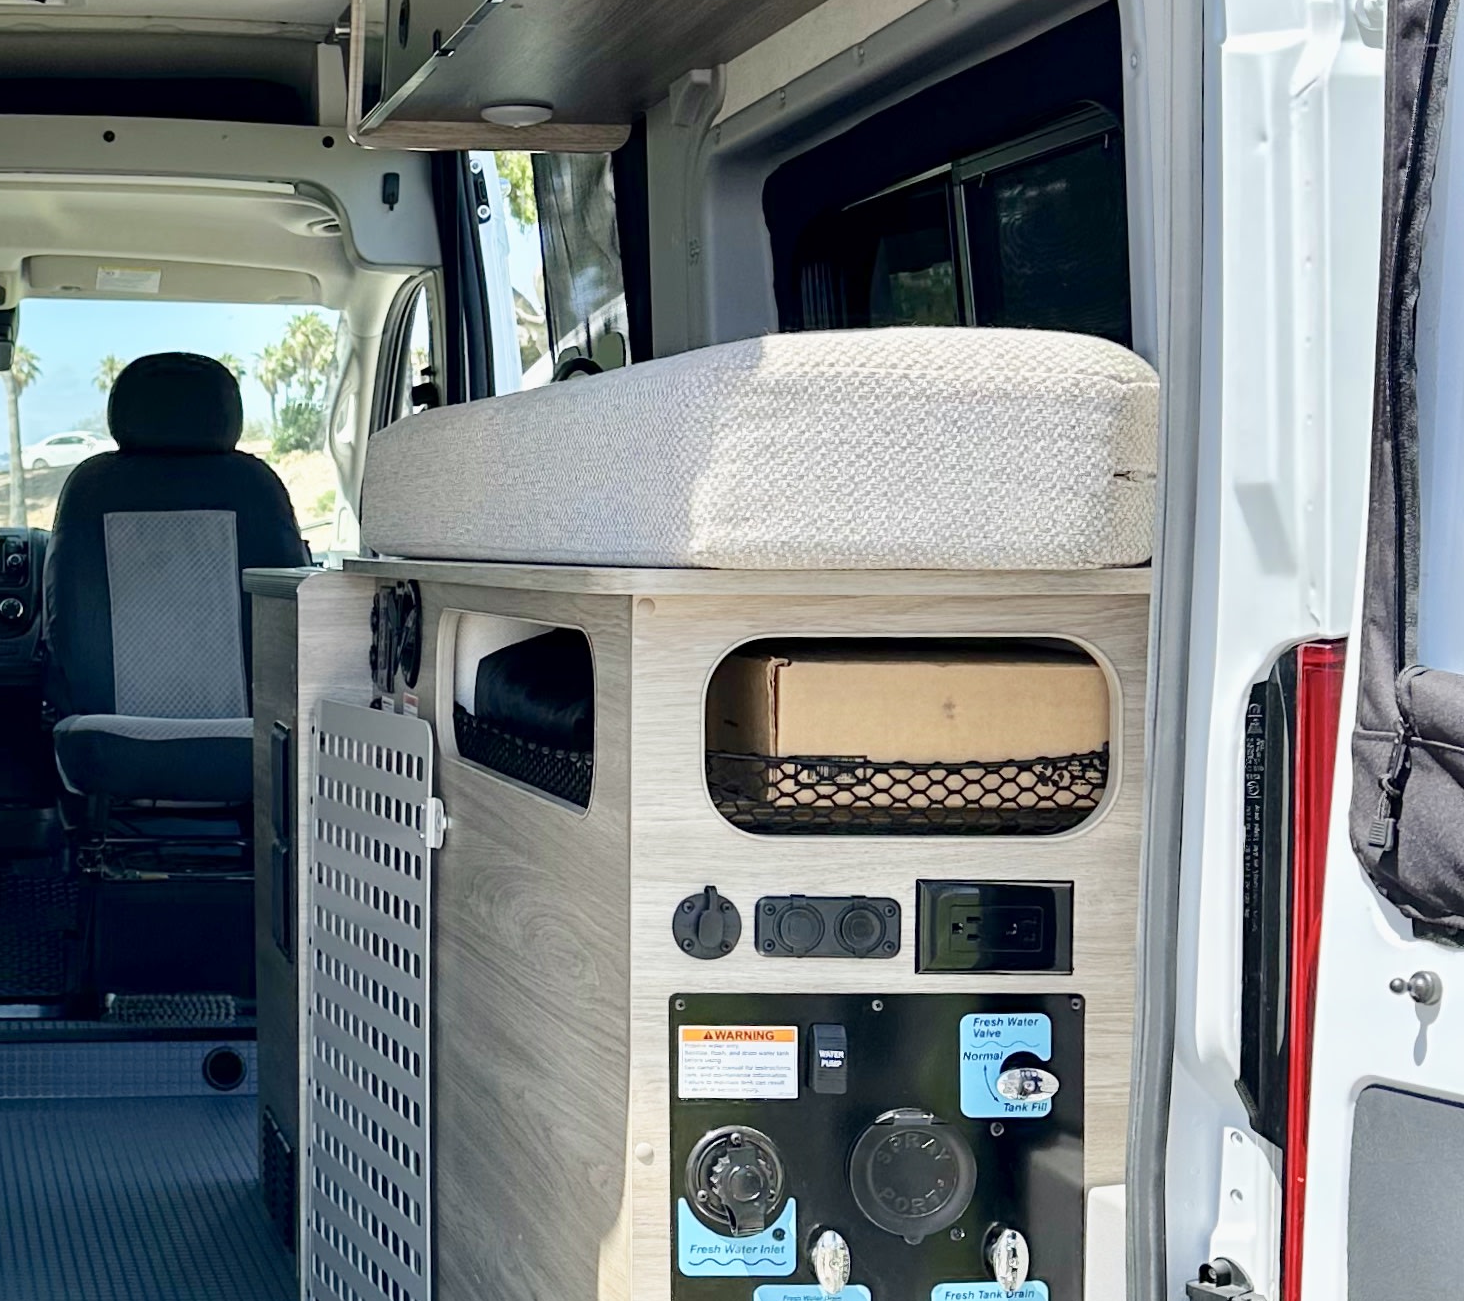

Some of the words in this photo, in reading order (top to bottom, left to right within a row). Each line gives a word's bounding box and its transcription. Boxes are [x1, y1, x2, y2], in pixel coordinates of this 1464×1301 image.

[973, 1017, 1003, 1027] Fresh
[1007, 1017, 1039, 1026] Water
[715, 1031, 774, 1040] WARNING
[973, 1029, 1001, 1038] Valve
[819, 1050, 844, 1058] WATER
[963, 1051, 1003, 1060] Normal
[821, 1059, 842, 1067] PUMP
[1004, 1103, 1027, 1112] Tank
[1031, 1103, 1047, 1111] Fill
[690, 1245, 720, 1253] Fresh
[724, 1245, 757, 1253] Water
[760, 1245, 785, 1254] Inlet
[945, 1291, 974, 1300] Fresh
[979, 1290, 1002, 1299] Tank
[1006, 1289, 1035, 1299] Drain
